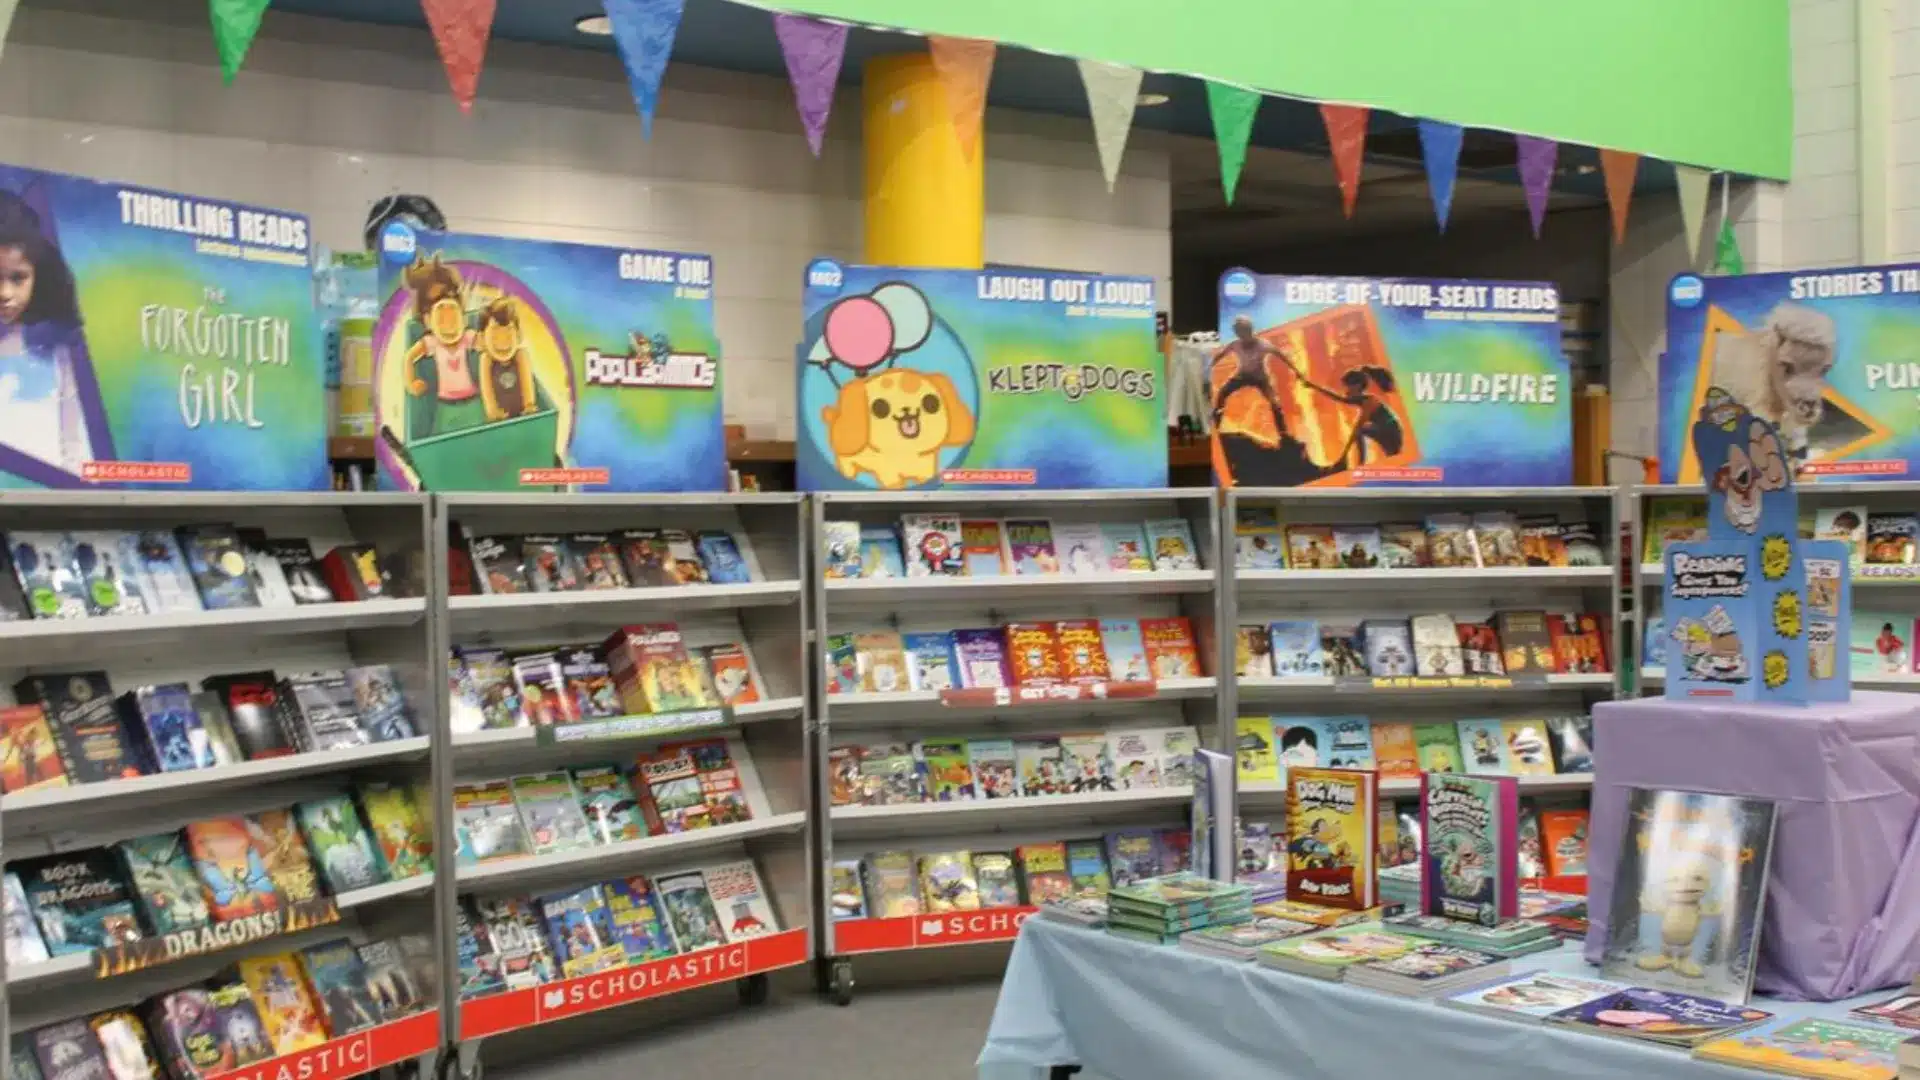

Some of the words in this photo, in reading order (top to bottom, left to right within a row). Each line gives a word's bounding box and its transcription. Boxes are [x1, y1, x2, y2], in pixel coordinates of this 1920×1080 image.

[118, 190, 234, 238] THRILLING
[238, 210, 307, 249] READS
[619, 253, 675, 282] GAME
[677, 258, 711, 285] ON!
[978, 276, 1045, 301] LAUGH
[1051, 279, 1090, 303] OUT
[1094, 280, 1156, 306] LOUD!
[1285, 282, 1488, 309] EDGE-OF-YOUR-SEAT
[1494, 287, 1558, 310] READS
[1790, 272, 1883, 299] STORIES
[141, 304, 290, 365] FORGOTTEN
[178, 364, 264, 428] GIRL
[1412, 371, 1558, 404] WILDFIRE
[98, 463, 189, 478] SCHOLASTIC
[534, 470, 609, 483] SCHOLASTIC
[165, 910, 283, 957] DRAGONS!
[568, 948, 744, 1006] SCHOLASTIC
